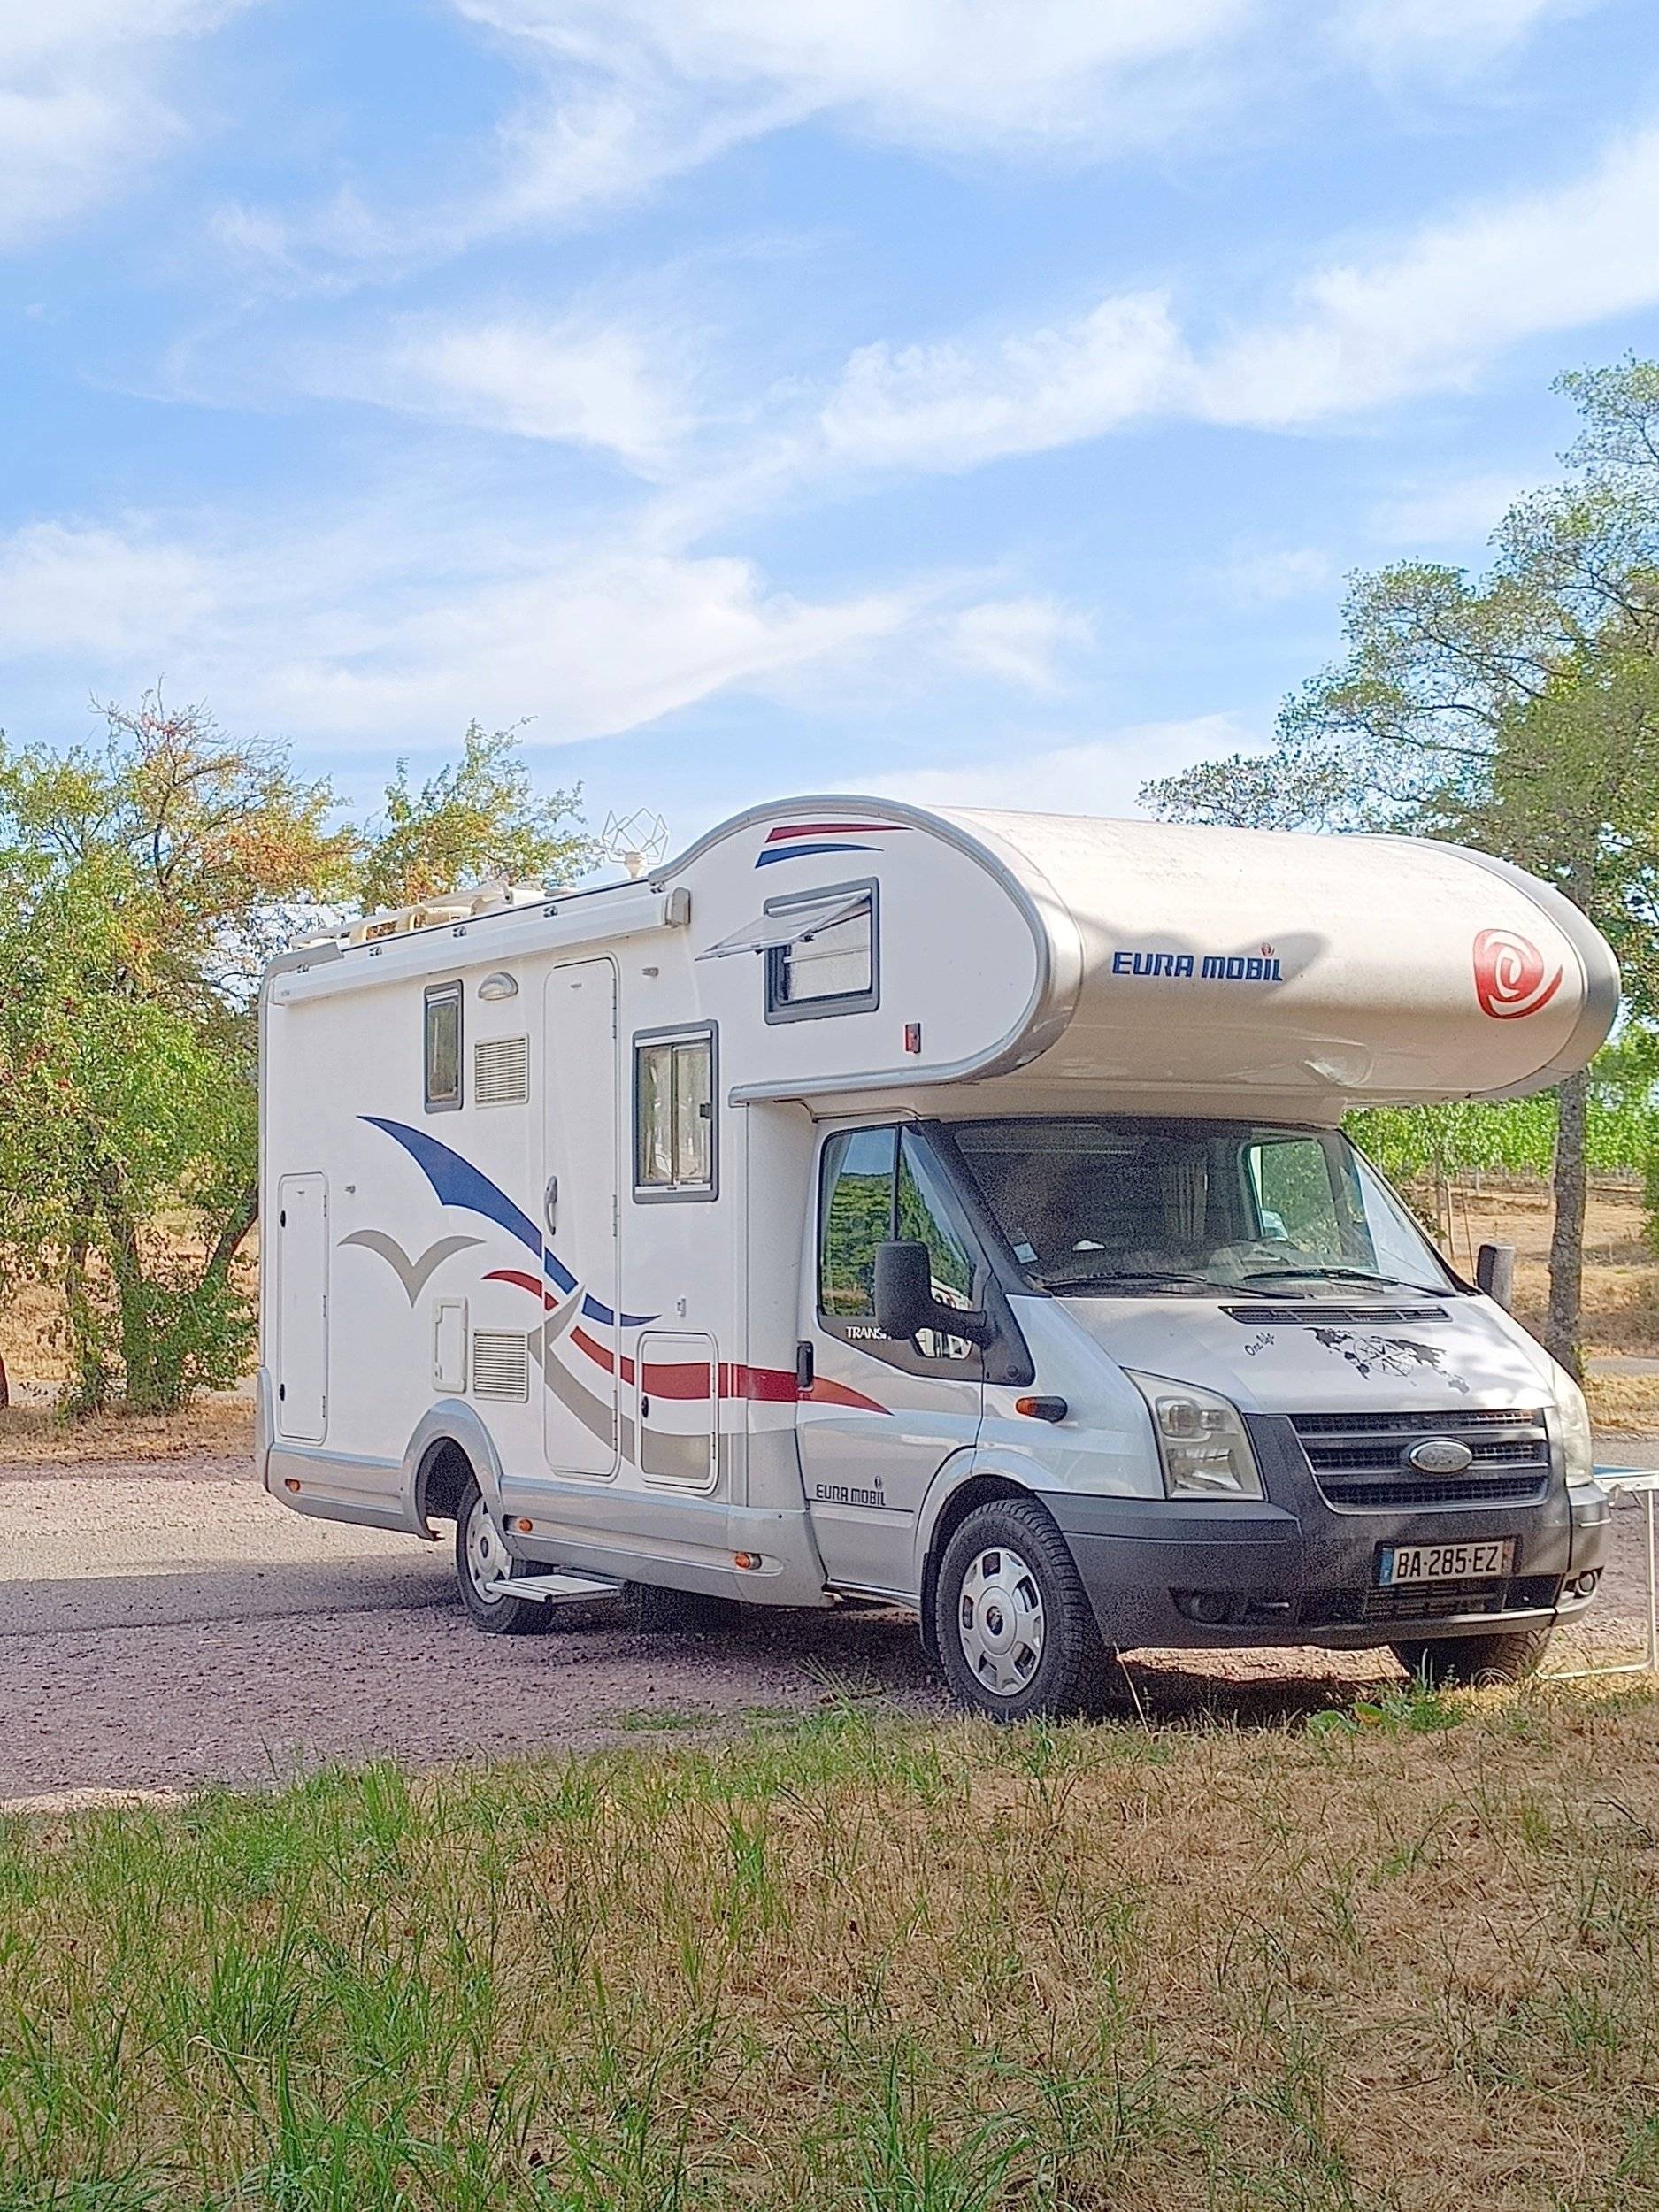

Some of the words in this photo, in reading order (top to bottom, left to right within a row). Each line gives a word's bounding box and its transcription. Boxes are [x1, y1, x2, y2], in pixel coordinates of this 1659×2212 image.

[1112, 951, 1194, 978] EURA
[1201, 955, 1283, 981] MOBIL
[816, 1483, 849, 1502] EURA
[850, 1487, 887, 1506] MOBIL
